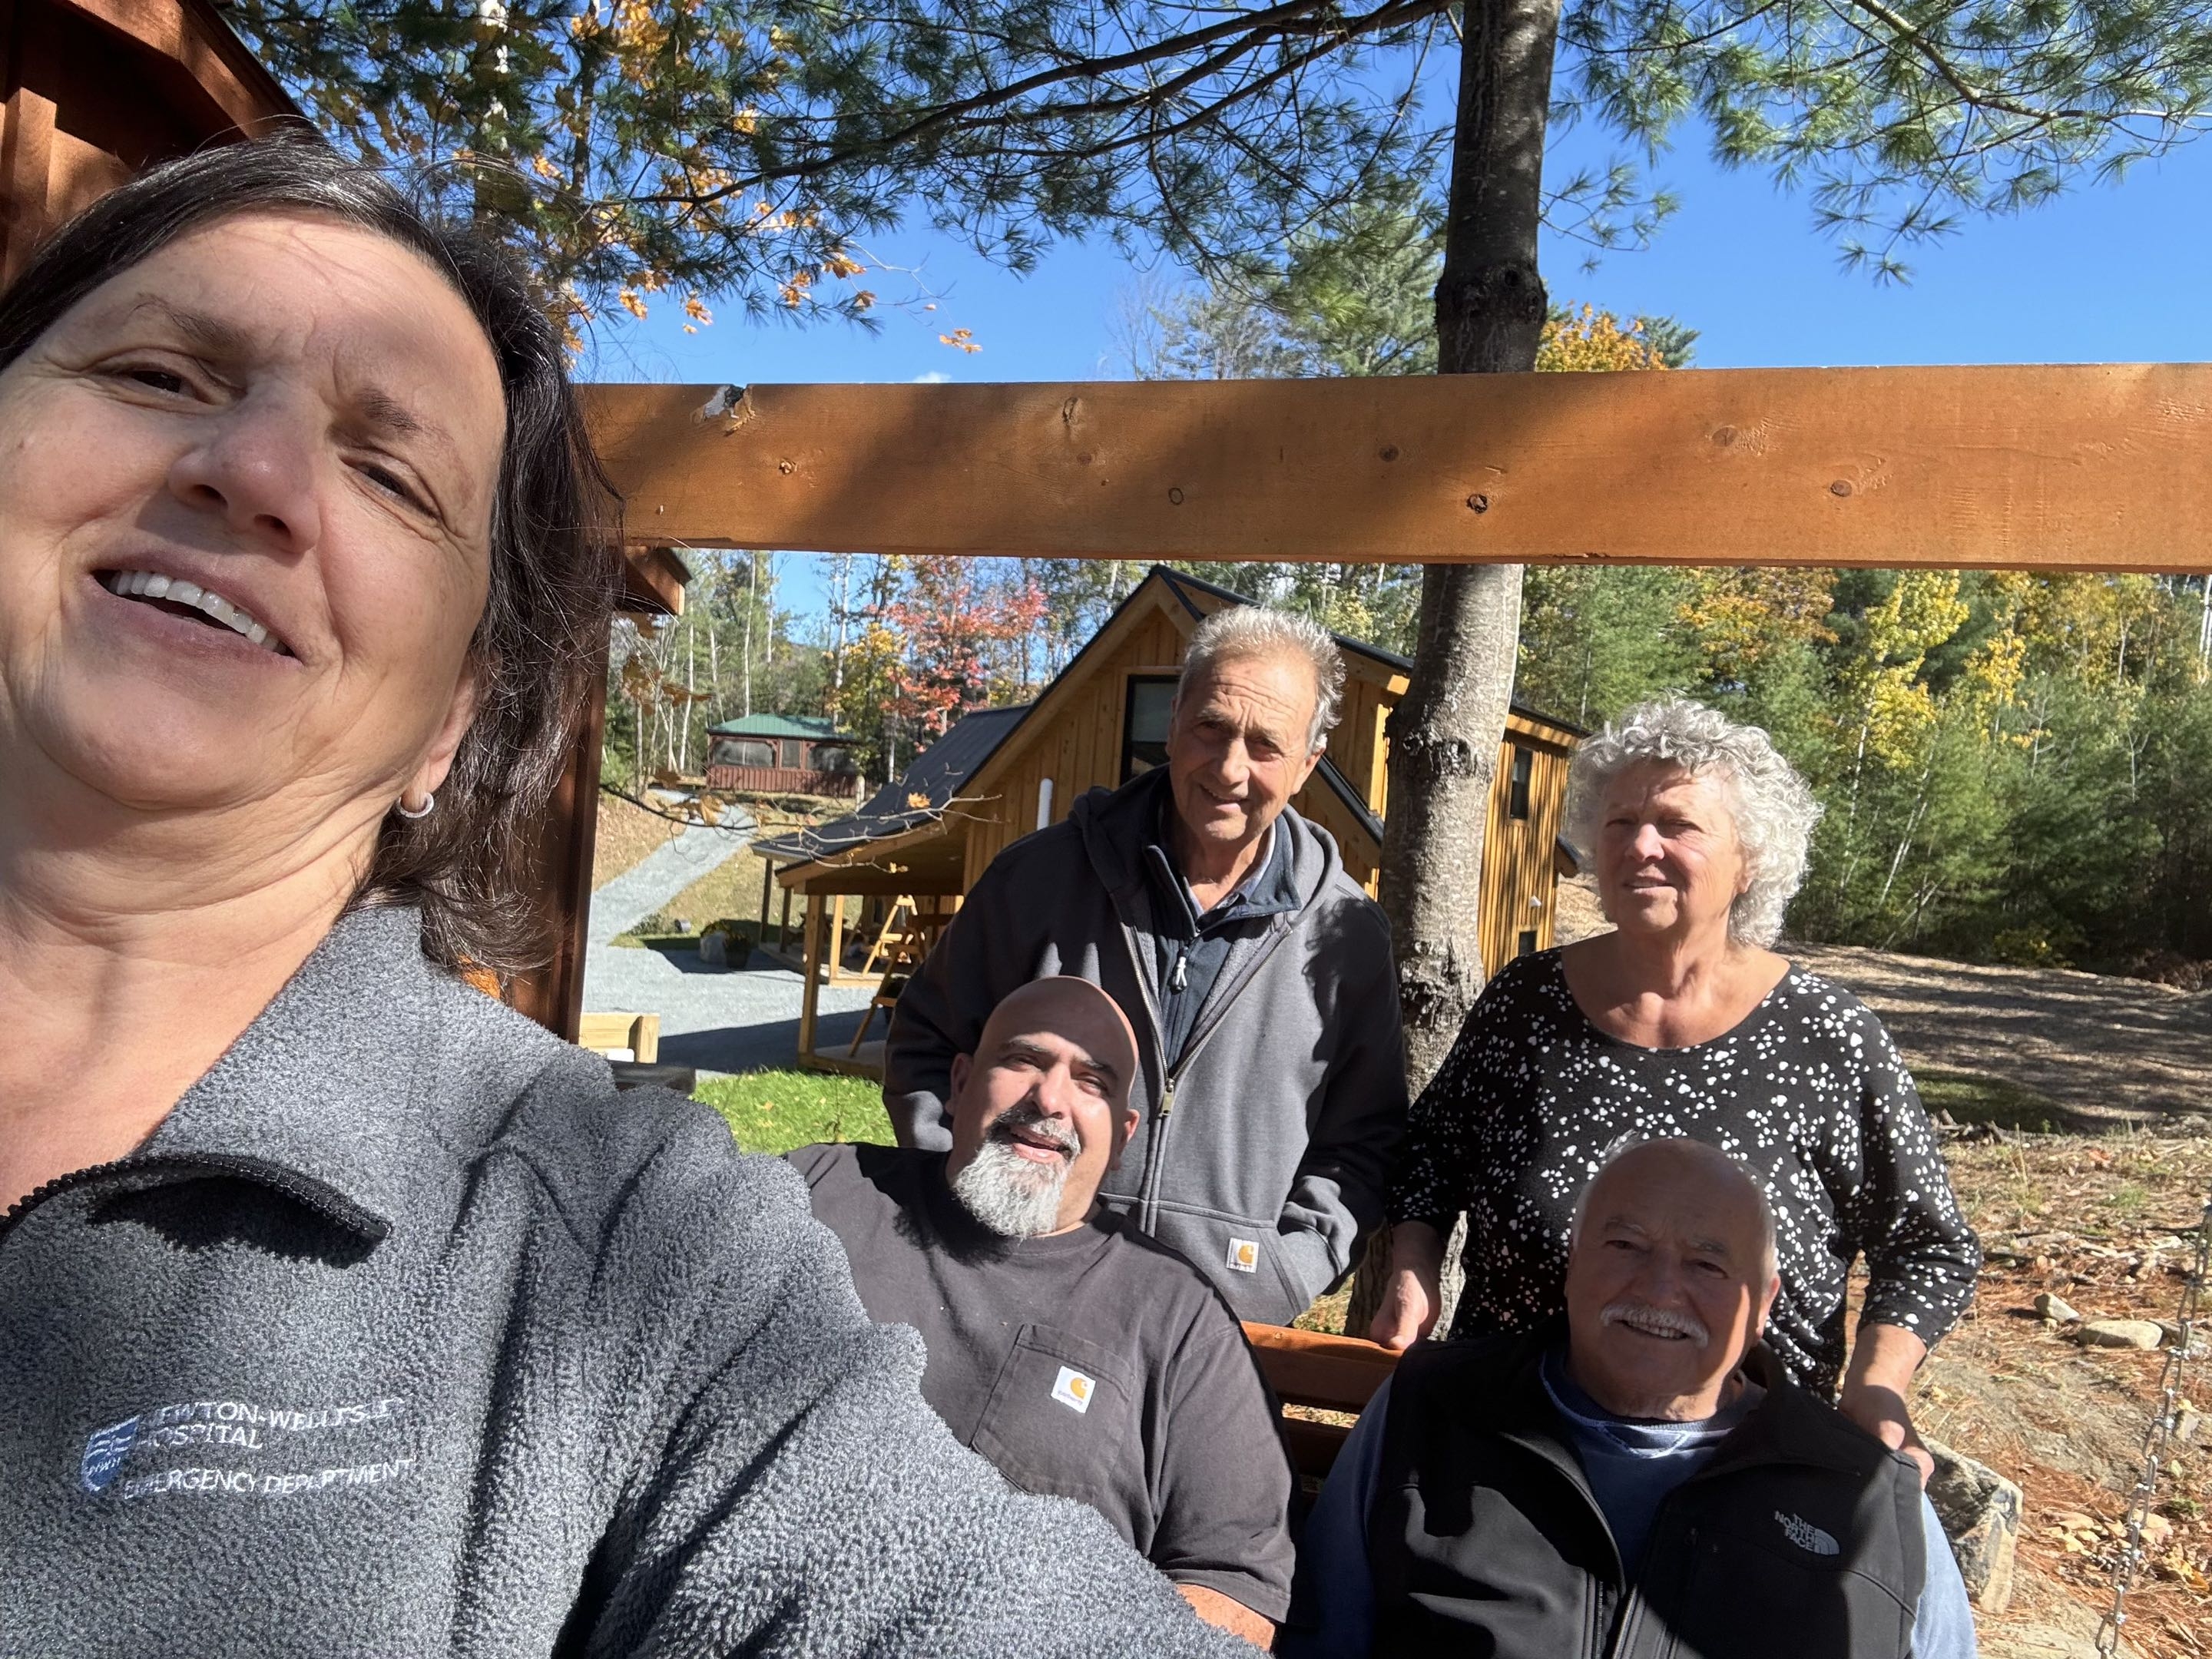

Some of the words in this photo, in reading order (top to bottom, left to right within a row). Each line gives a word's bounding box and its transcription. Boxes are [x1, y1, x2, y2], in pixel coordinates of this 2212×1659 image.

[1774, 1510, 1815, 1543] NORTH
[1793, 1512, 1816, 1533] THE
[1784, 1528, 1815, 1552] FACE
